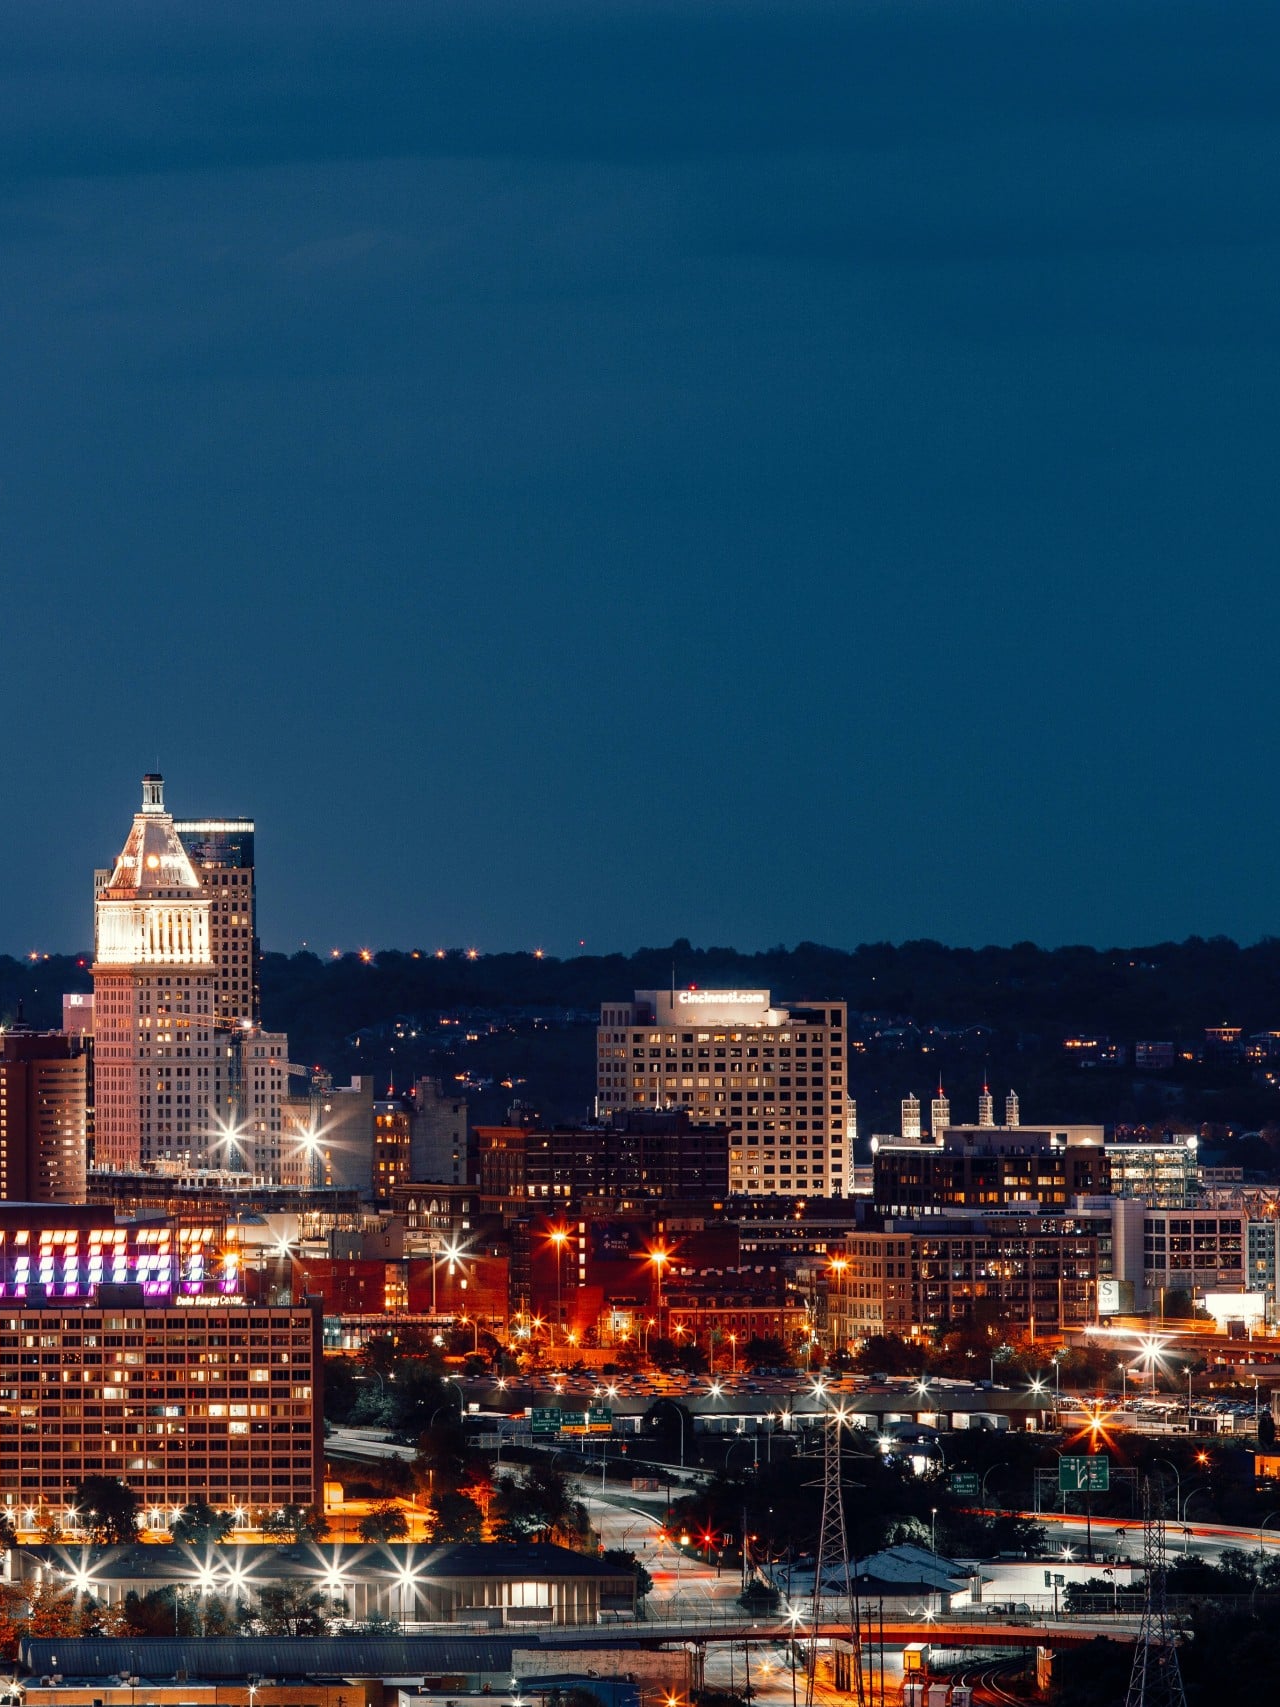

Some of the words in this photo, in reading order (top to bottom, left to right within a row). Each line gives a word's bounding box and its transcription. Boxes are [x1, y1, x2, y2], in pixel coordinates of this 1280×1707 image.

[679, 991, 765, 1004] Cincinnati.com
[195, 1295, 220, 1307] Energy
[220, 1295, 243, 1305] Center
